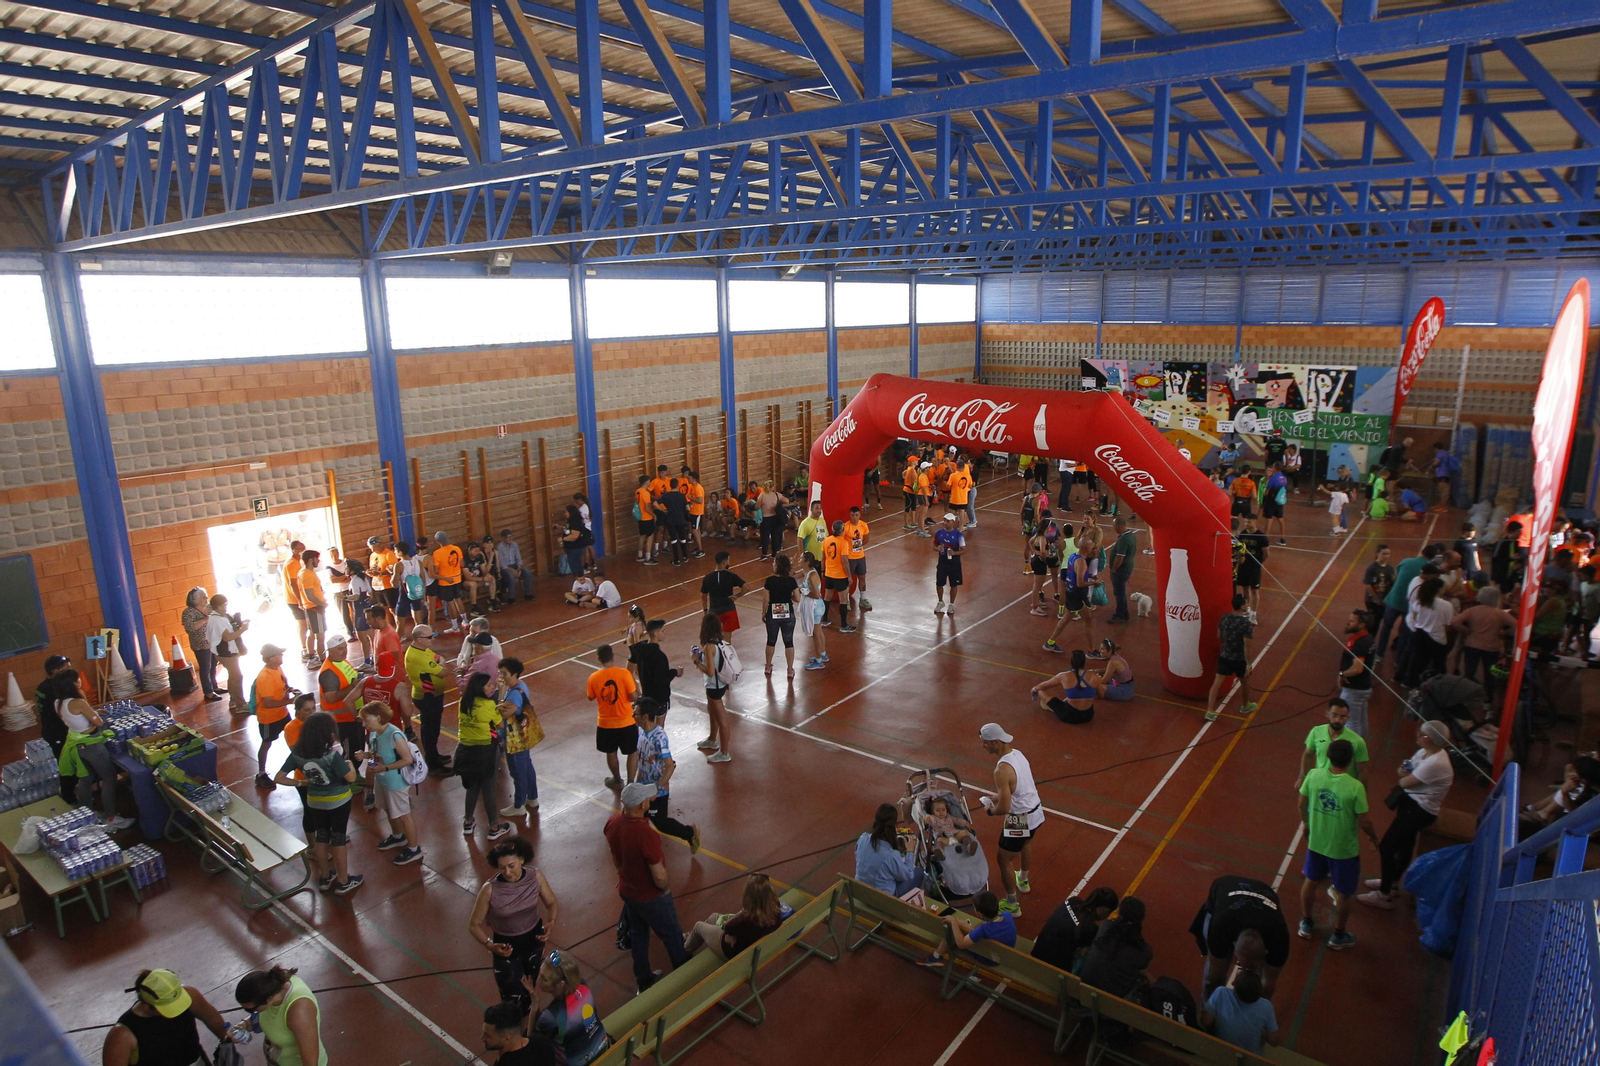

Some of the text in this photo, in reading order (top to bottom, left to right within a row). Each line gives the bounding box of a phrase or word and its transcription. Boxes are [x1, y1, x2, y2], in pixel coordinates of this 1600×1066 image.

[823, 409, 856, 456] Coca-Cola
[898, 392, 1019, 445] Coca-Cola
[1308, 426, 1330, 439] DEL
[1331, 428, 1381, 443] VIENTO
[1364, 416, 1382, 429] AL
[1094, 444, 1167, 502] Coca-Cola
